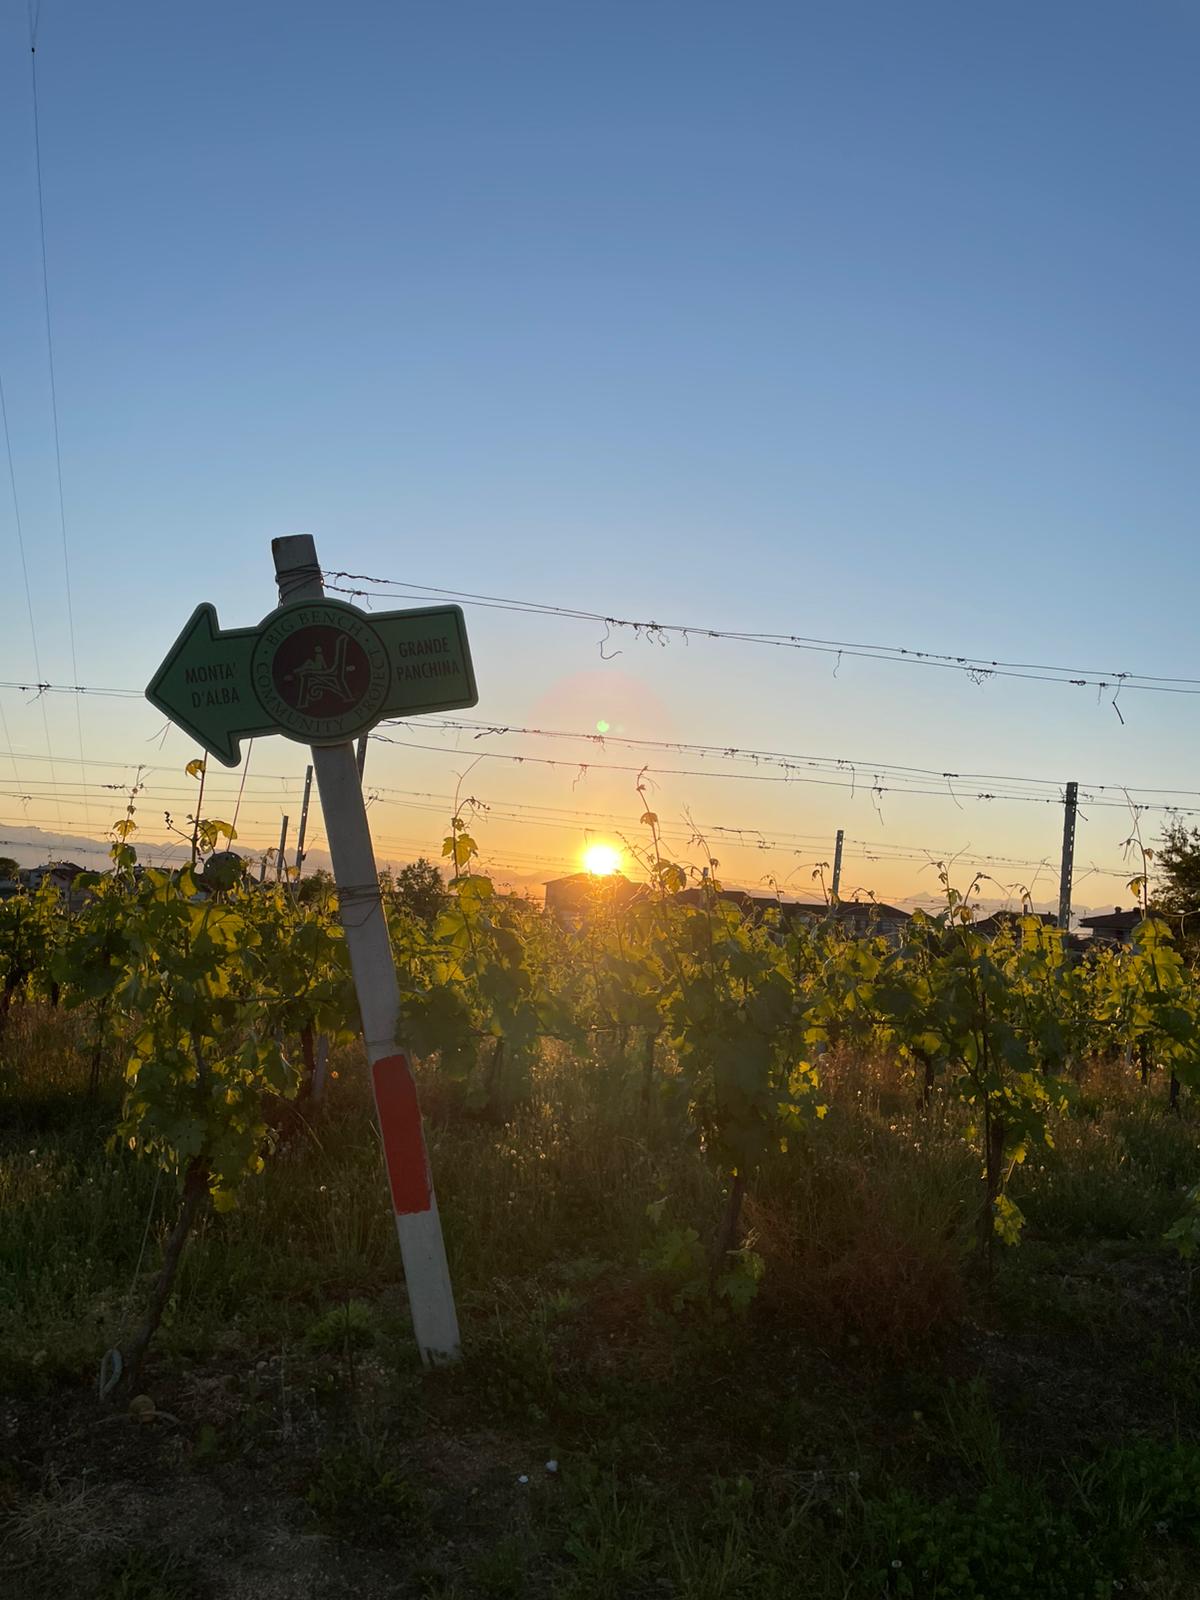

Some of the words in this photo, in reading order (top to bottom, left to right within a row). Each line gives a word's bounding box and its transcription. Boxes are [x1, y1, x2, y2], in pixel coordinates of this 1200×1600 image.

[266, 618, 294, 645] BIG
[298, 611, 363, 637] BENCH
[398, 636, 451, 658] GRANDE
[185, 661, 236, 685] MONTA'
[396, 659, 461, 681] PANCHINA
[191, 687, 241, 708] D'ALBA
[256, 662, 345, 732] COMMUNITY
[353, 649, 386, 720] PROJECT
